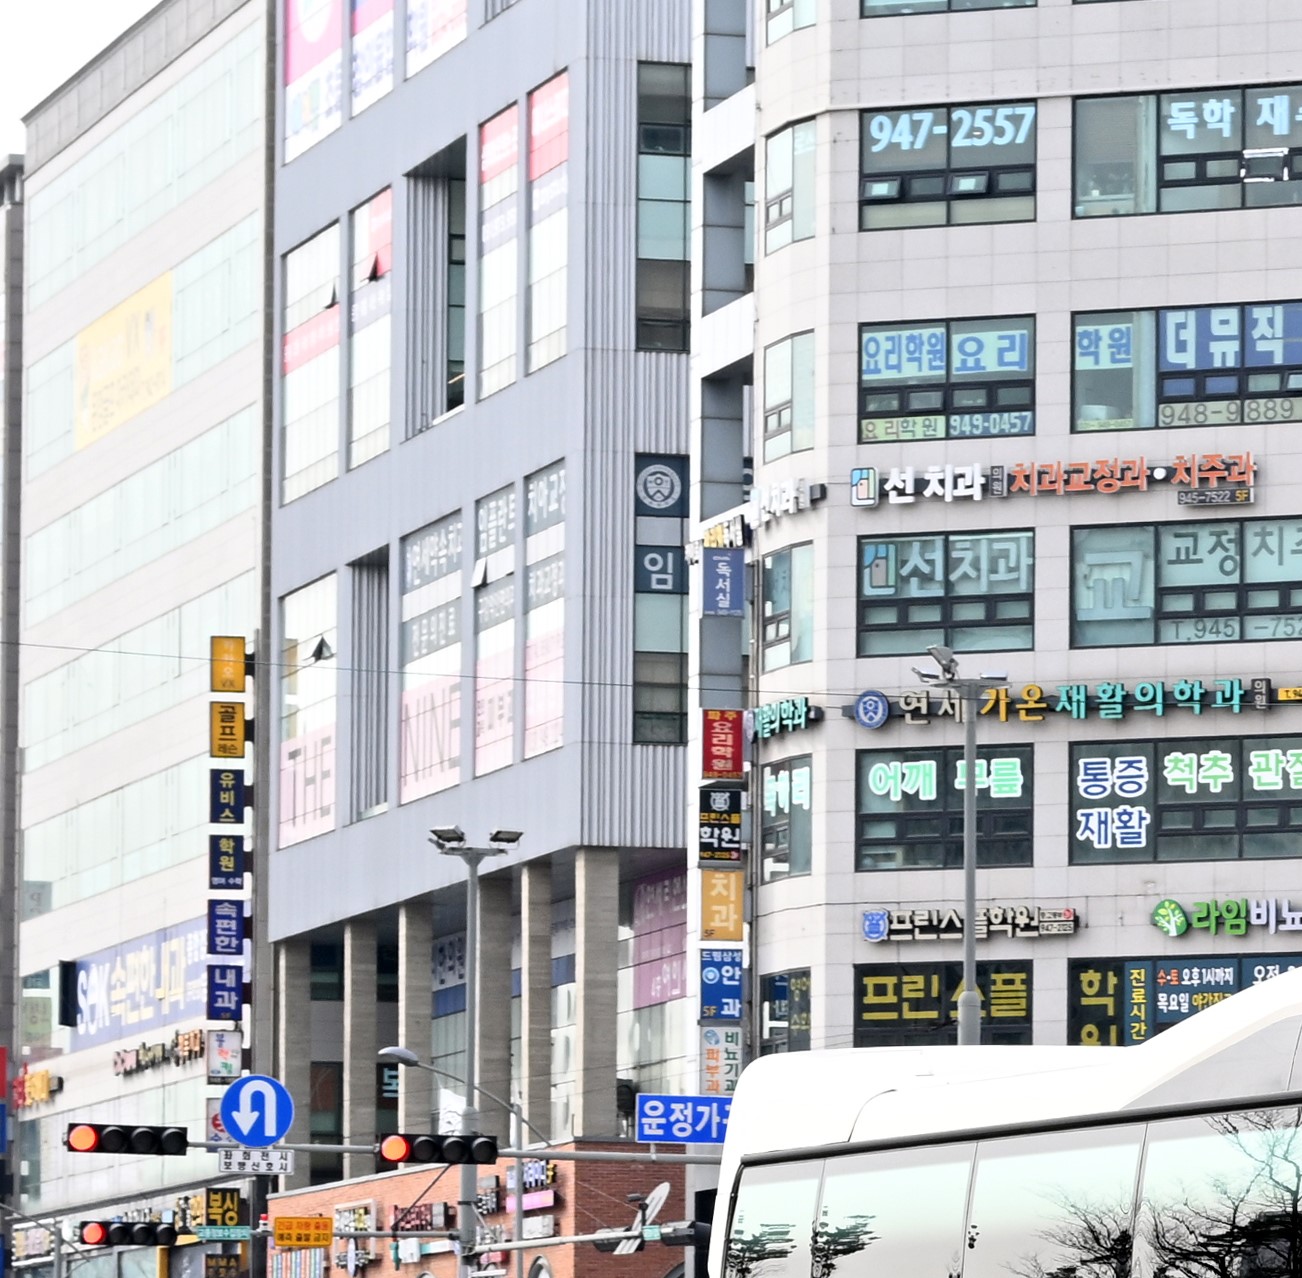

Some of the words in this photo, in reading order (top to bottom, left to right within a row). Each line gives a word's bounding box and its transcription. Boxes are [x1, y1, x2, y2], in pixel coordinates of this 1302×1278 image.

[869, 107, 1035, 152] 947-2557
[1166, 98, 1235, 139] 독학
[862, 330, 946, 376] 요리학원
[1165, 305, 1285, 366] 더뮤직
[949, 411, 1032, 436] 949-0457
[1178, 489, 1232, 504] 945-7522
[643, 551, 674, 592] 임
[899, 537, 1034, 594] 선치과
[1166, 527, 1241, 578] 교정
[715, 561, 732, 609] 독서실
[218, 704, 237, 742] 골프
[219, 771, 236, 822] 유비스
[868, 760, 938, 802] 어깨
[1075, 754, 1149, 799] 통증
[1162, 749, 1236, 794] 척추
[699, 825, 741, 849] 학원
[1075, 804, 1151, 850] 재활
[218, 838, 236, 873] 학원
[709, 873, 739, 932] 치과
[214, 902, 240, 954] 속편한
[213, 968, 240, 1010] 내과
[1129, 968, 1147, 1041] 진료시간
[1156, 993, 1190, 1013] 목요일
[207, 1190, 240, 1227] 복싱
